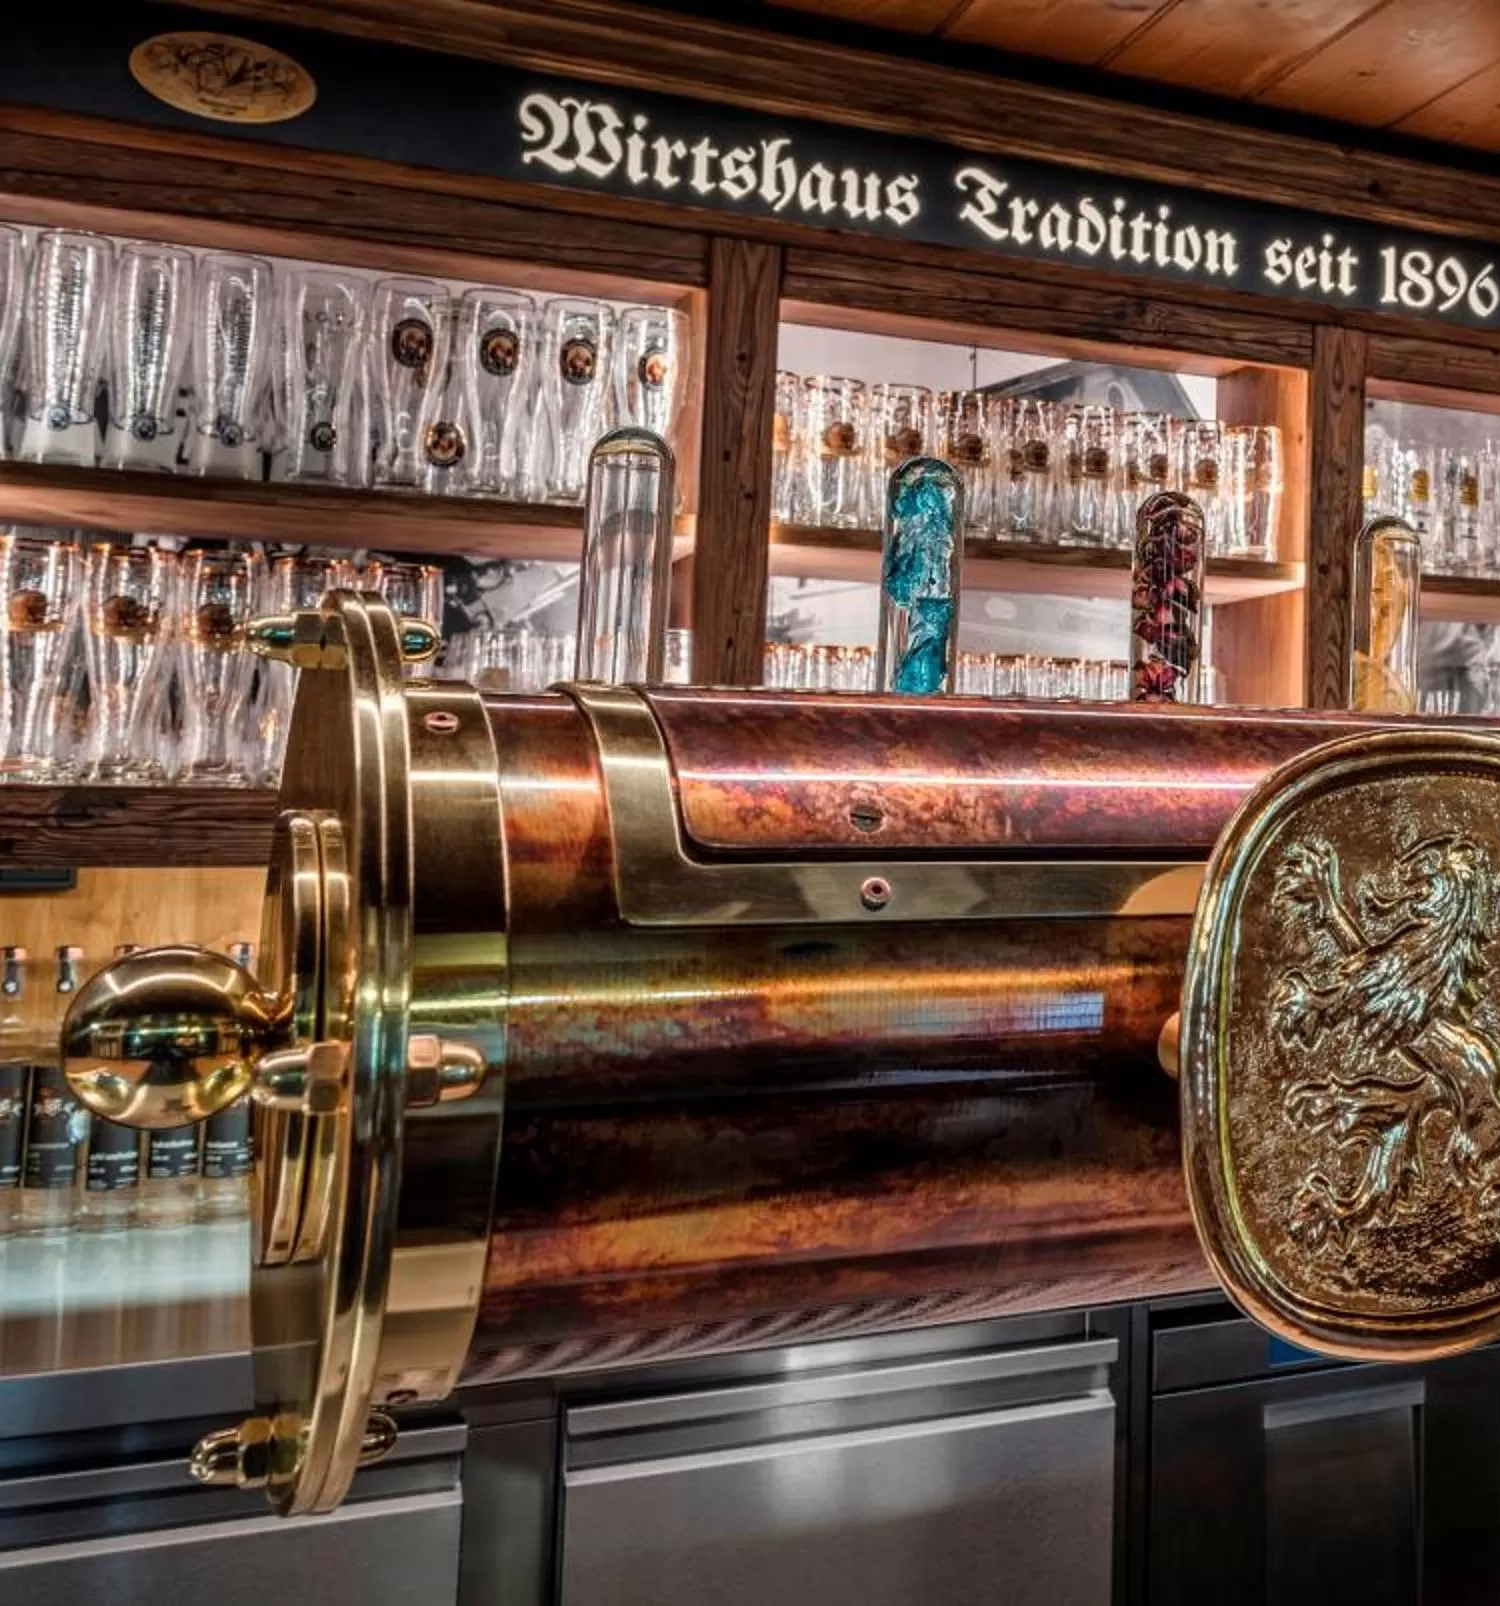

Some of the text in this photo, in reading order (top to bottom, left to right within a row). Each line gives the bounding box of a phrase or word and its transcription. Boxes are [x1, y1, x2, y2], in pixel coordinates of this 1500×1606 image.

[518, 93, 1500, 319] Wirtshaus Tradition seit 1896
